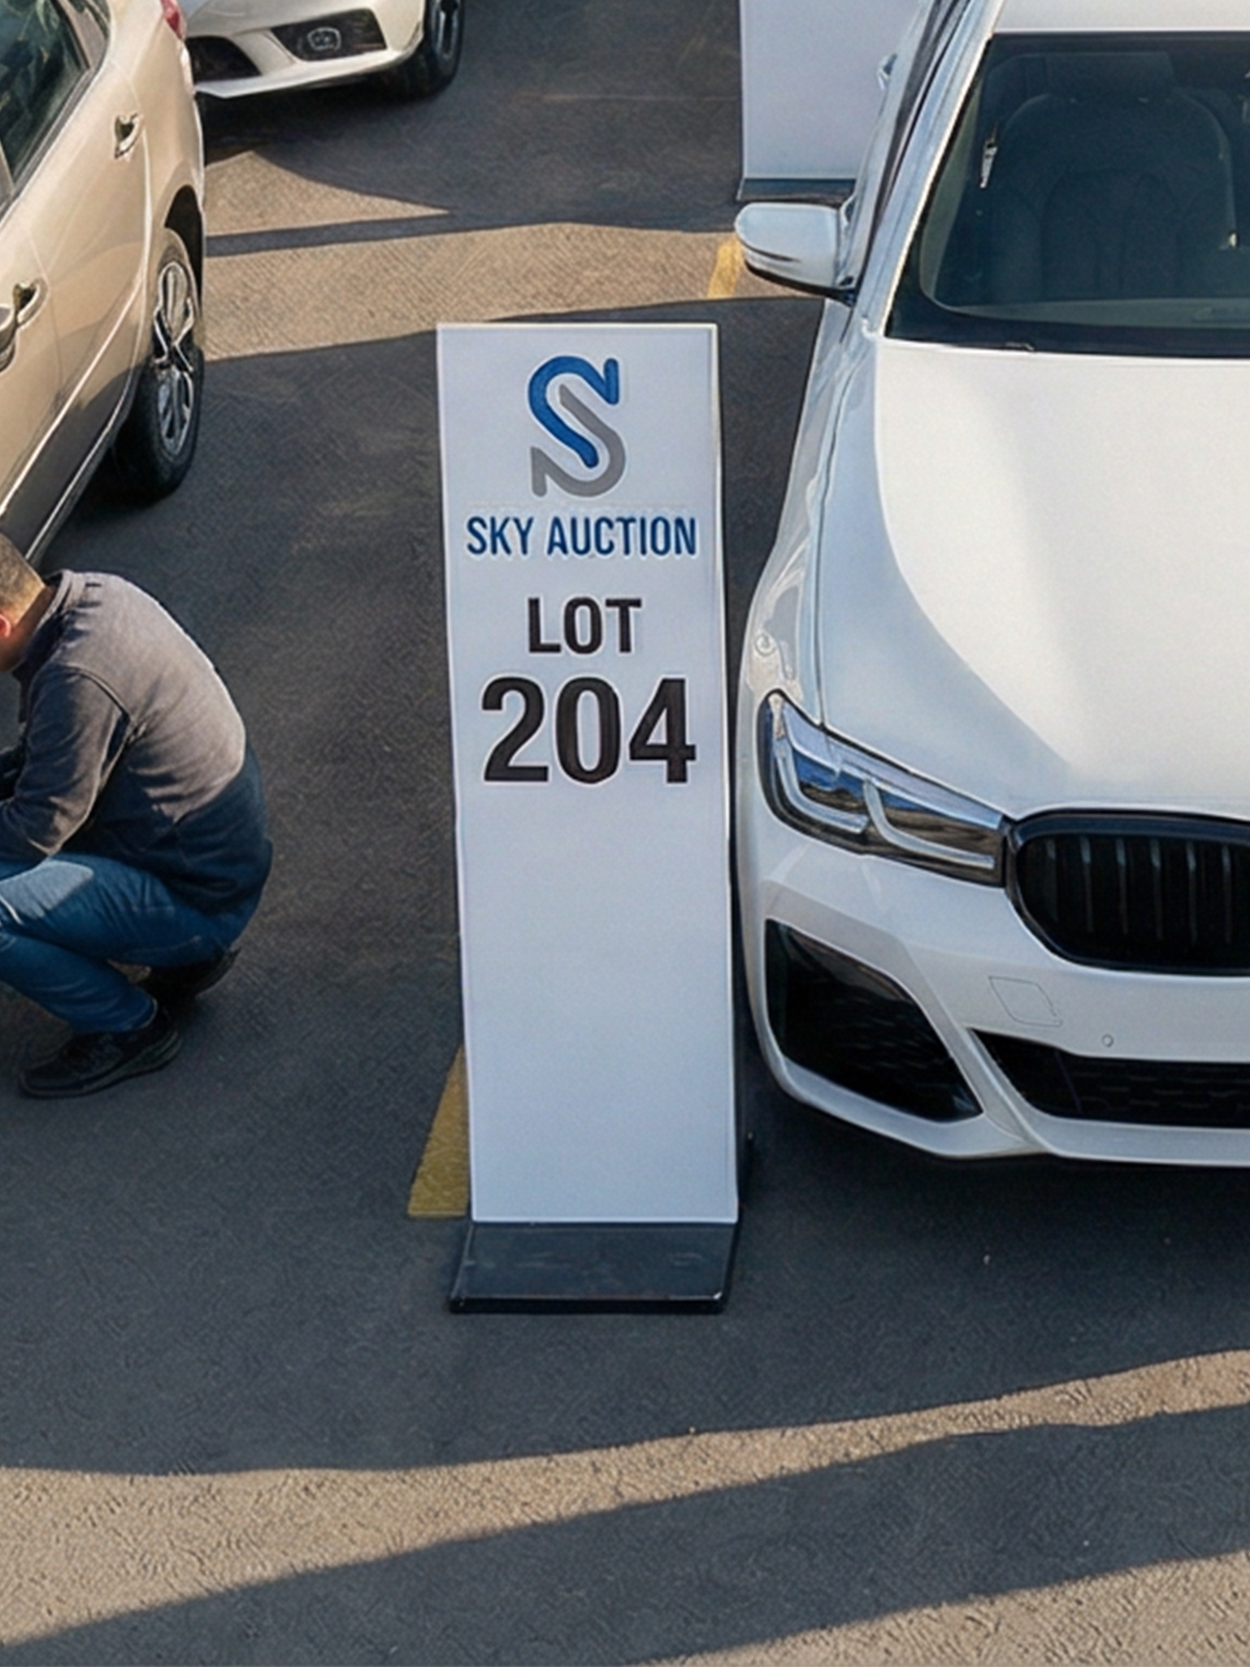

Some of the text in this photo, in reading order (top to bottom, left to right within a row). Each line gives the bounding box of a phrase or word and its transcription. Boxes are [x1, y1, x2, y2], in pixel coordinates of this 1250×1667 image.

[467, 516, 696, 555] SKY AUCTION
[528, 596, 642, 654] LOT
[481, 677, 696, 784] 204
